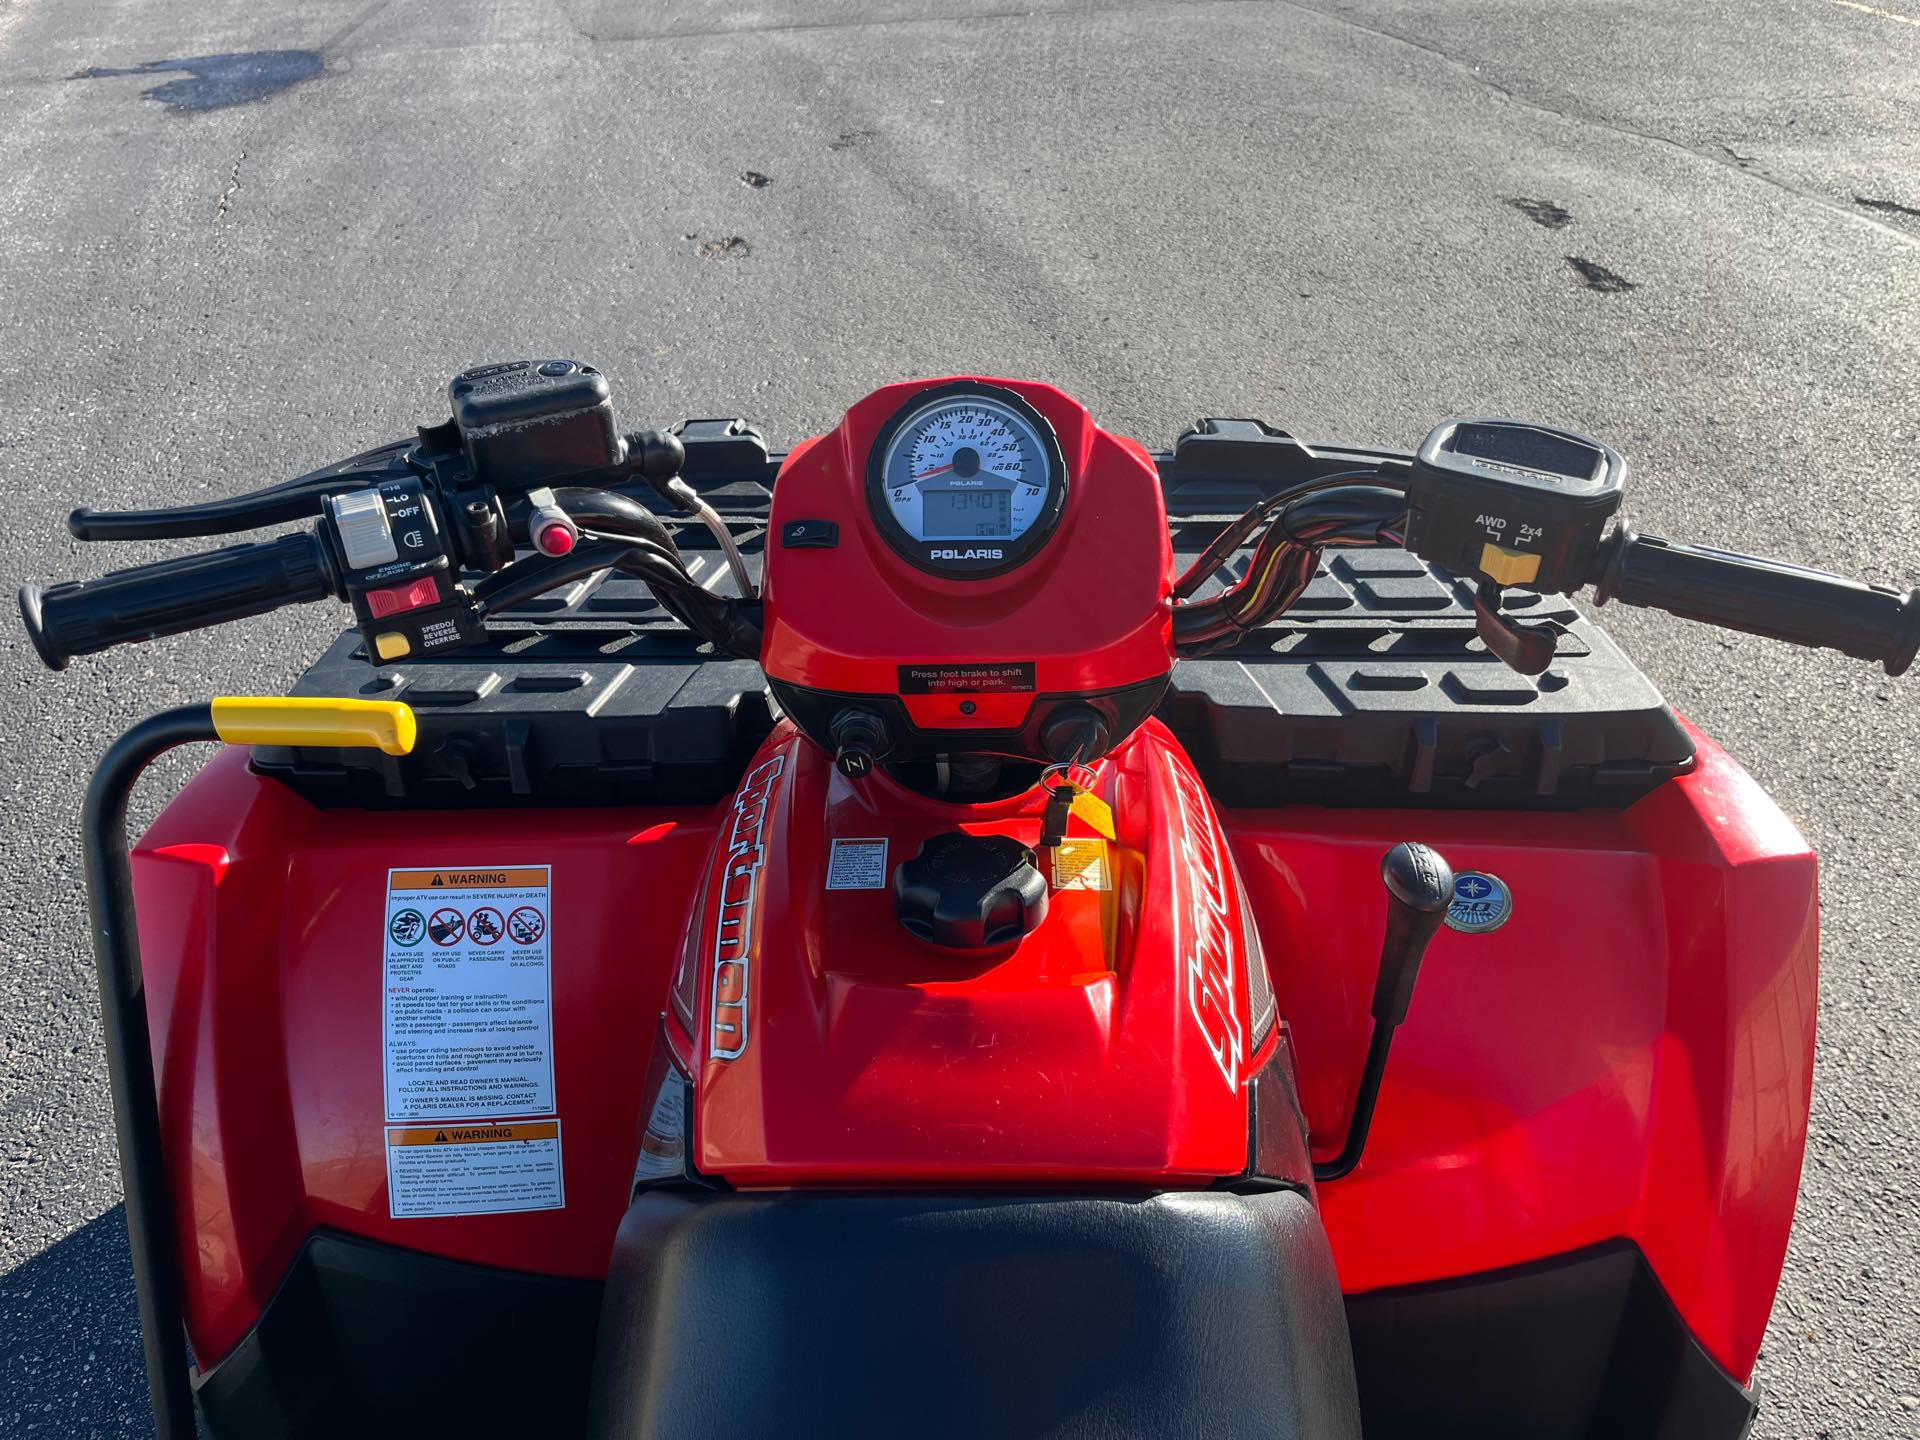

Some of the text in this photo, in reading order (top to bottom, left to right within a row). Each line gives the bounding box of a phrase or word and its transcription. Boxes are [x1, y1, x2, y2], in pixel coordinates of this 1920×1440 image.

[940, 421, 951, 429] 15
[976, 419, 992, 427] 30
[923, 435, 936, 443] 10
[1001, 443, 1017, 451] 50
[916, 454, 924, 462] 5
[1005, 463, 1019, 471] 60
[1475, 462, 1561, 483] POLARIS
[894, 489, 902, 497] 0
[1025, 488, 1039, 496] 70
[394, 494, 409, 503] LO
[951, 493, 993, 509] 1340
[398, 506, 419, 518] OFF
[1475, 514, 1507, 529] AWD
[1519, 524, 1543, 537] 2x4
[930, 549, 1003, 560] POLARIS
[378, 561, 412, 573] ENGINE
[424, 627, 458, 640] REVERSE
[424, 633, 461, 648] OVERRIDE
[911, 670, 937, 678] Press
[940, 670, 958, 678] foot
[1002, 668, 1022, 676] shift
[928, 679, 945, 687] into
[948, 678, 968, 688] high
[983, 678, 1006, 687] park.
[449, 875, 506, 884] WARNING
[709, 755, 784, 1060] Sportsman
[452, 1129, 512, 1140] WARNING
